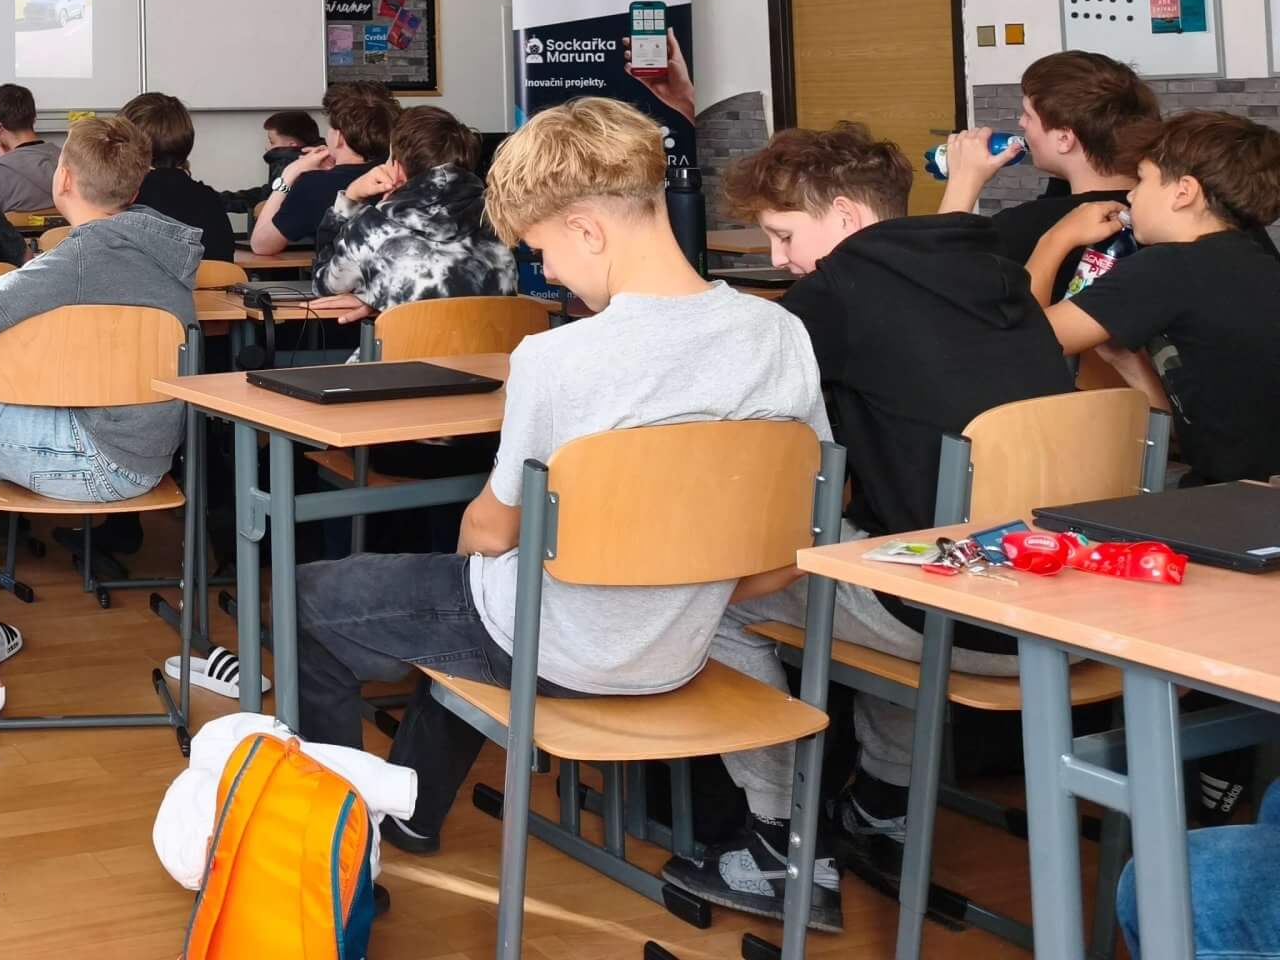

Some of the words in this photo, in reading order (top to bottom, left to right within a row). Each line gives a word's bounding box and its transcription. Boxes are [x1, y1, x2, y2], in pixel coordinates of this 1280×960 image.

[546, 38, 616, 51] Sockařka
[546, 51, 605, 63] Maruna
[524, 77, 563, 87] Inovační
[565, 77, 607, 88] projekty.
